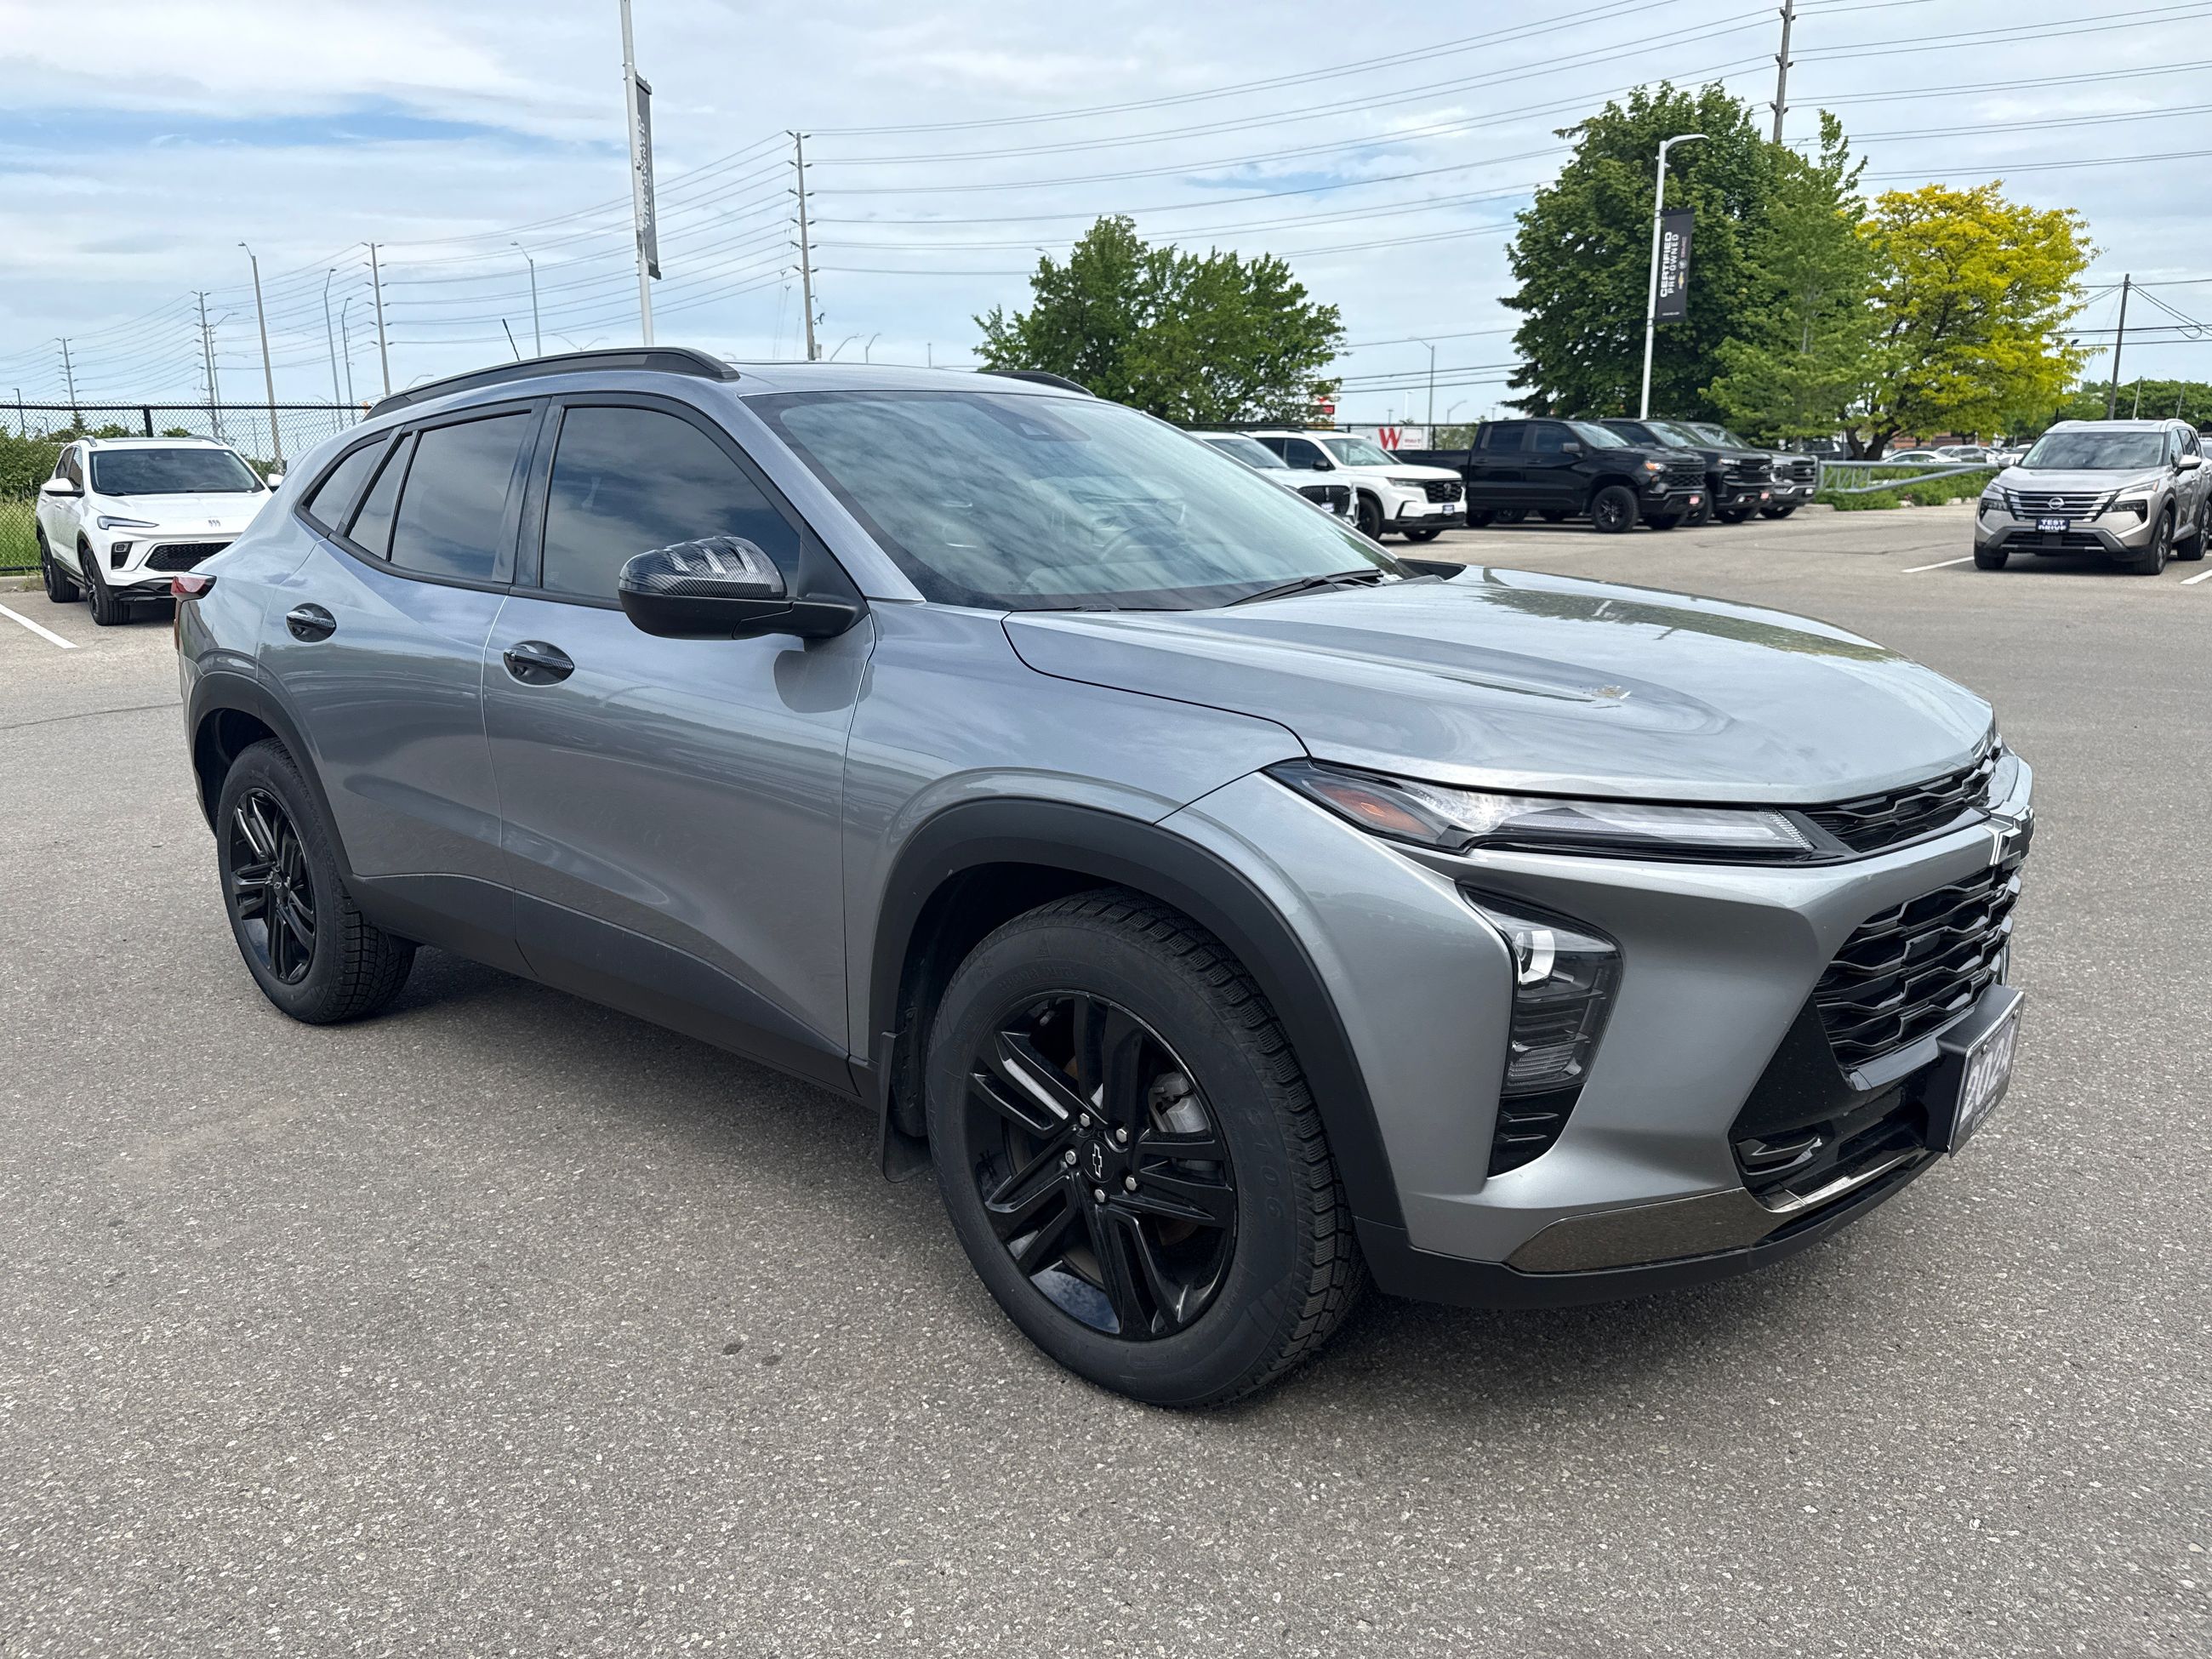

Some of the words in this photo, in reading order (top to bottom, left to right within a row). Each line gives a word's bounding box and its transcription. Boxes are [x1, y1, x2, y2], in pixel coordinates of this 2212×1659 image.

[1660, 231, 1673, 298] CERTIFIED
[1668, 234, 1679, 294] PRE-OWNED
[1378, 427, 1402, 450] W
[1960, 1023, 2015, 1123] 2024
